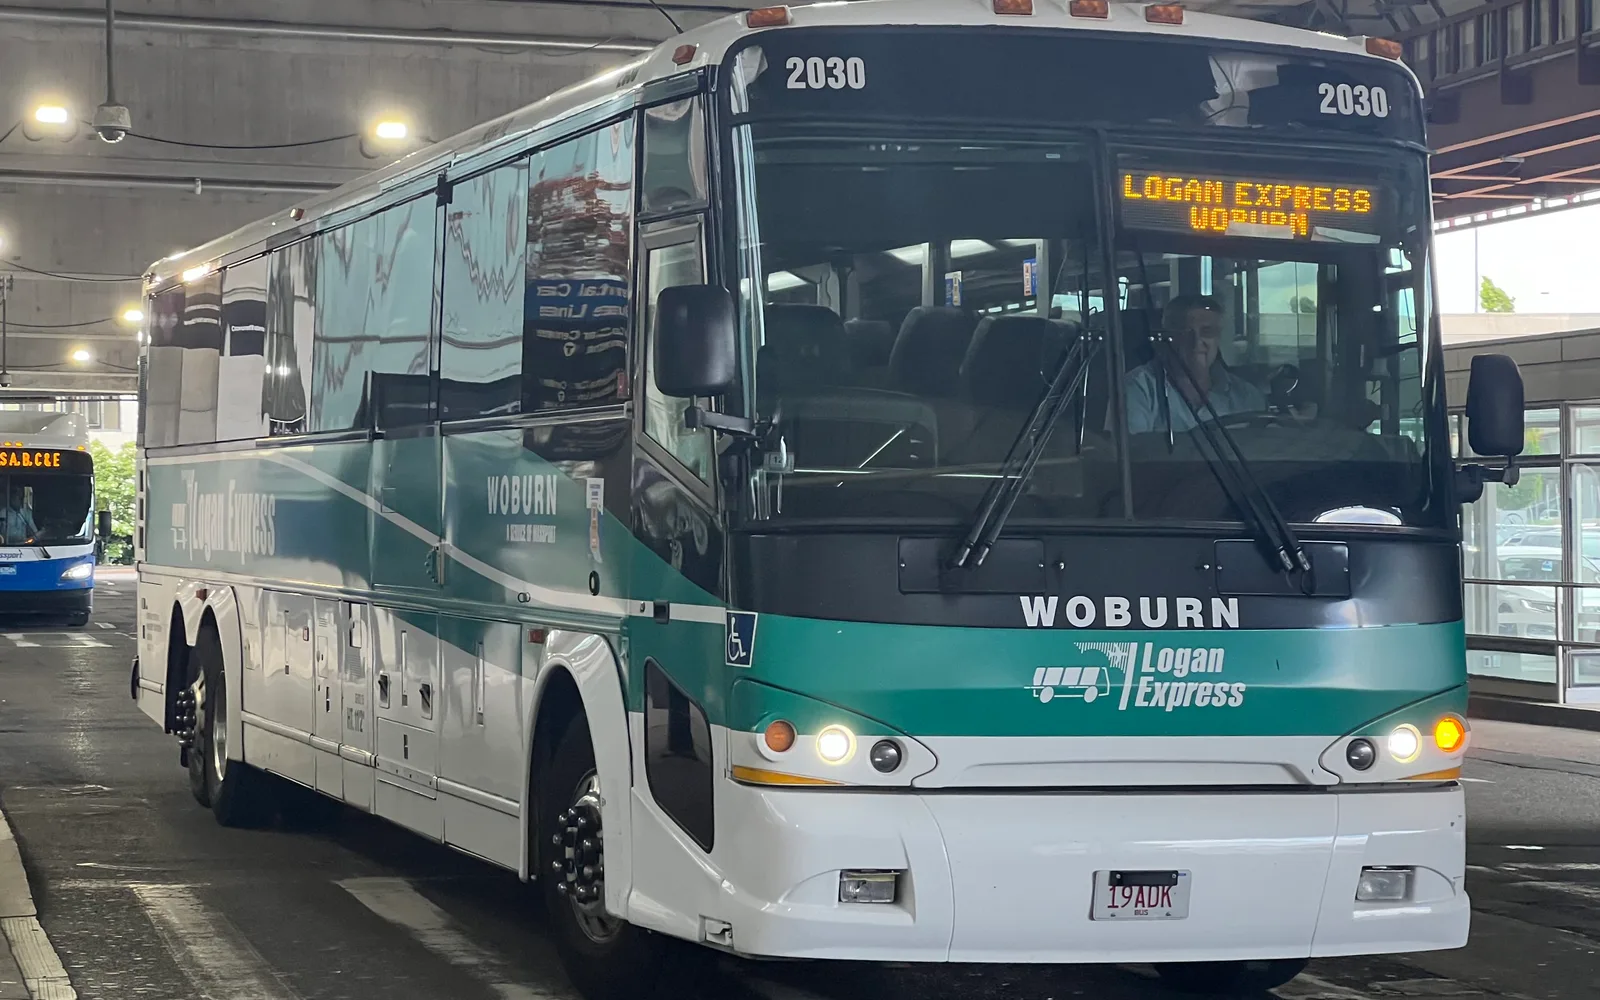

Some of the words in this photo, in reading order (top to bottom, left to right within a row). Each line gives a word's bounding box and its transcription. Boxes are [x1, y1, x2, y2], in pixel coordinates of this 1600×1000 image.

[785, 56, 866, 90] 2030
[1318, 82, 1389, 118] 2030
[1123, 174, 1224, 204] LOGAN
[1234, 182, 1372, 213] EXPRESS
[487, 475, 557, 515] WOBURN
[193, 481, 224, 562] Logan
[228, 479, 276, 566] Express
[1019, 595, 1240, 628] WOBURN
[1141, 642, 1225, 678] Logan
[1134, 676, 1246, 712] Express
[1107, 884, 1173, 909] 19ADK
